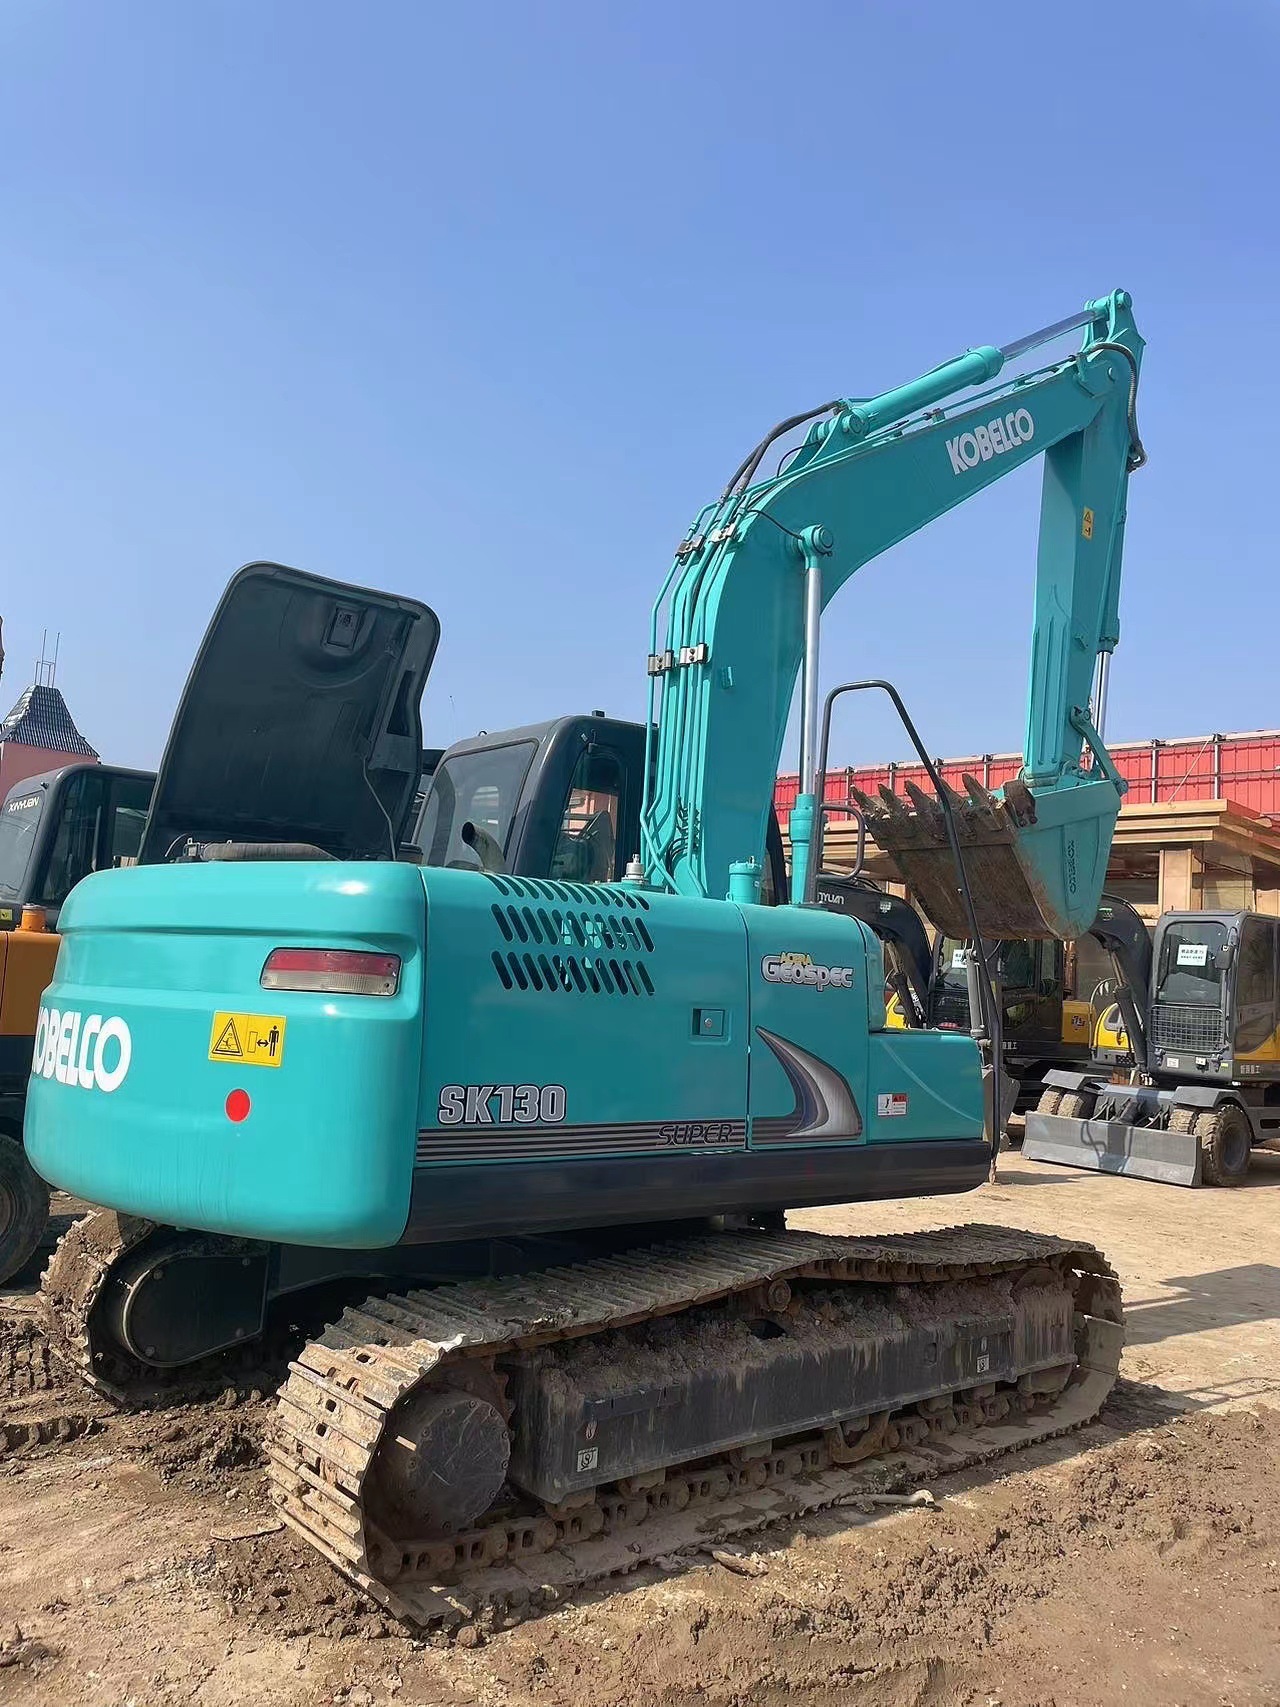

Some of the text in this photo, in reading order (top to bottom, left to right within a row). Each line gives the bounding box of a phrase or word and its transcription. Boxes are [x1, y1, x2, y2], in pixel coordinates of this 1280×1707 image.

[945, 408, 1034, 475] KOBELCO
[32, 1006, 132, 1092] OBELCO
[438, 1084, 567, 1125] SK130
[657, 1123, 733, 1146] SUPER
